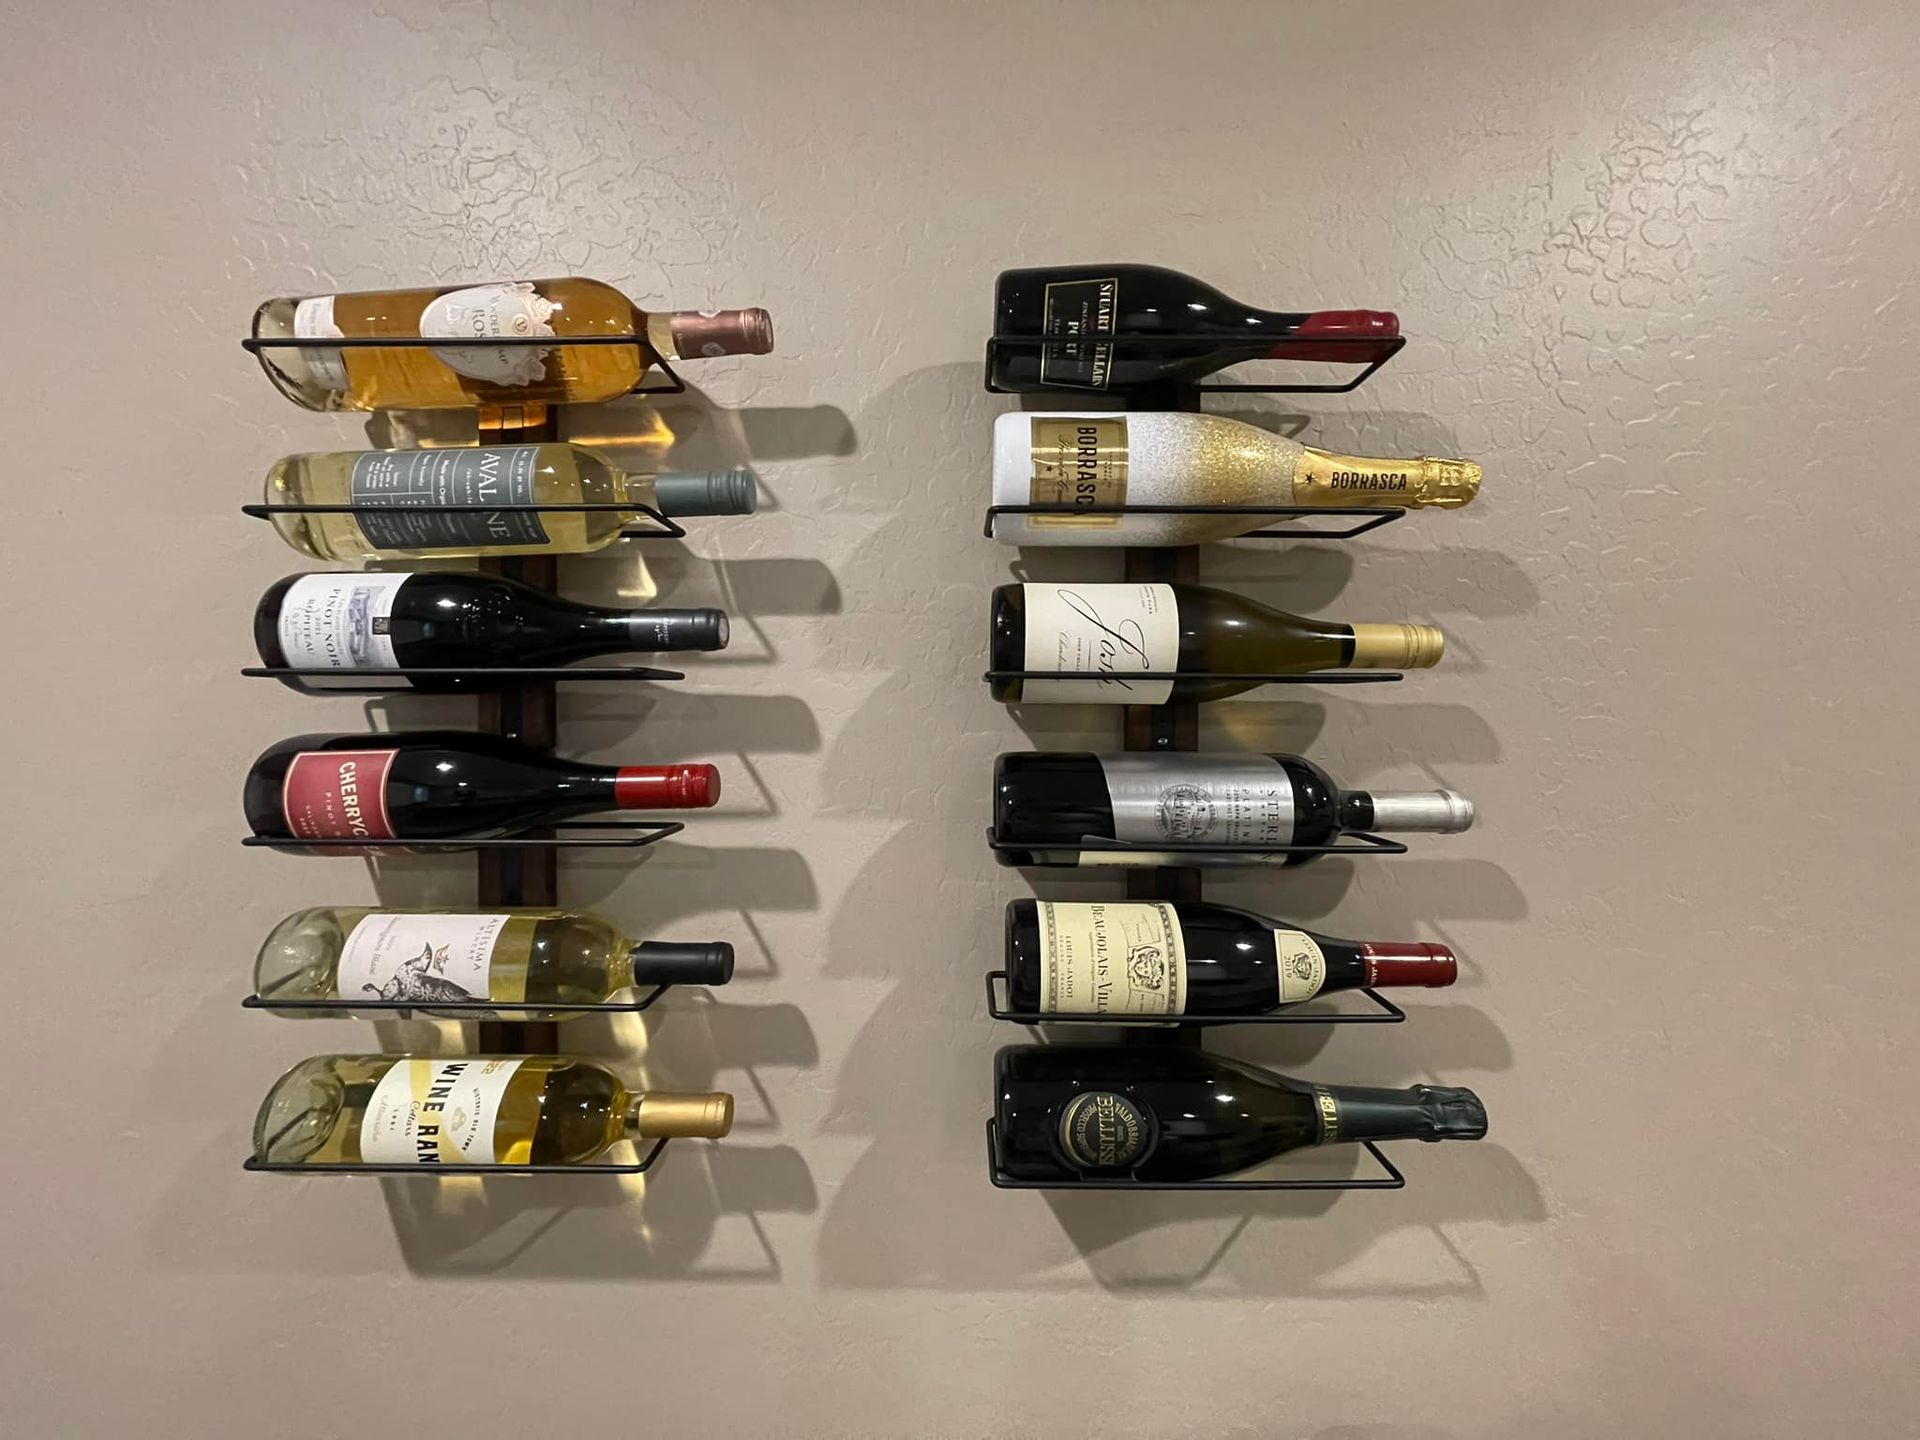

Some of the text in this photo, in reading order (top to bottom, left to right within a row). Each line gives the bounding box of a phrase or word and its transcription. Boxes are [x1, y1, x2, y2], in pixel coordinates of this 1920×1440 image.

[472, 309, 485, 339] ROS
[1080, 300, 1089, 336] ZINFAND
[1097, 284, 1114, 332] STUART
[478, 453, 510, 539] AVALNE
[1076, 427, 1098, 505] BORRASC
[1331, 471, 1408, 491] BORRASCA
[323, 588, 342, 667] PINOT NOIR
[1057, 589, 1150, 690] Josh
[325, 791, 336, 826] PINOT
[338, 761, 374, 846] CHERRYC
[1242, 788, 1252, 839] PLATIN
[1066, 968, 1074, 998] JADOT
[1091, 905, 1113, 1014] BEAUJOLAIS-VILLA
[1284, 955, 1293, 979] 2019
[416, 1062, 470, 1163] WINE RAN
[1096, 1095, 1116, 1165] BELLUSSI
